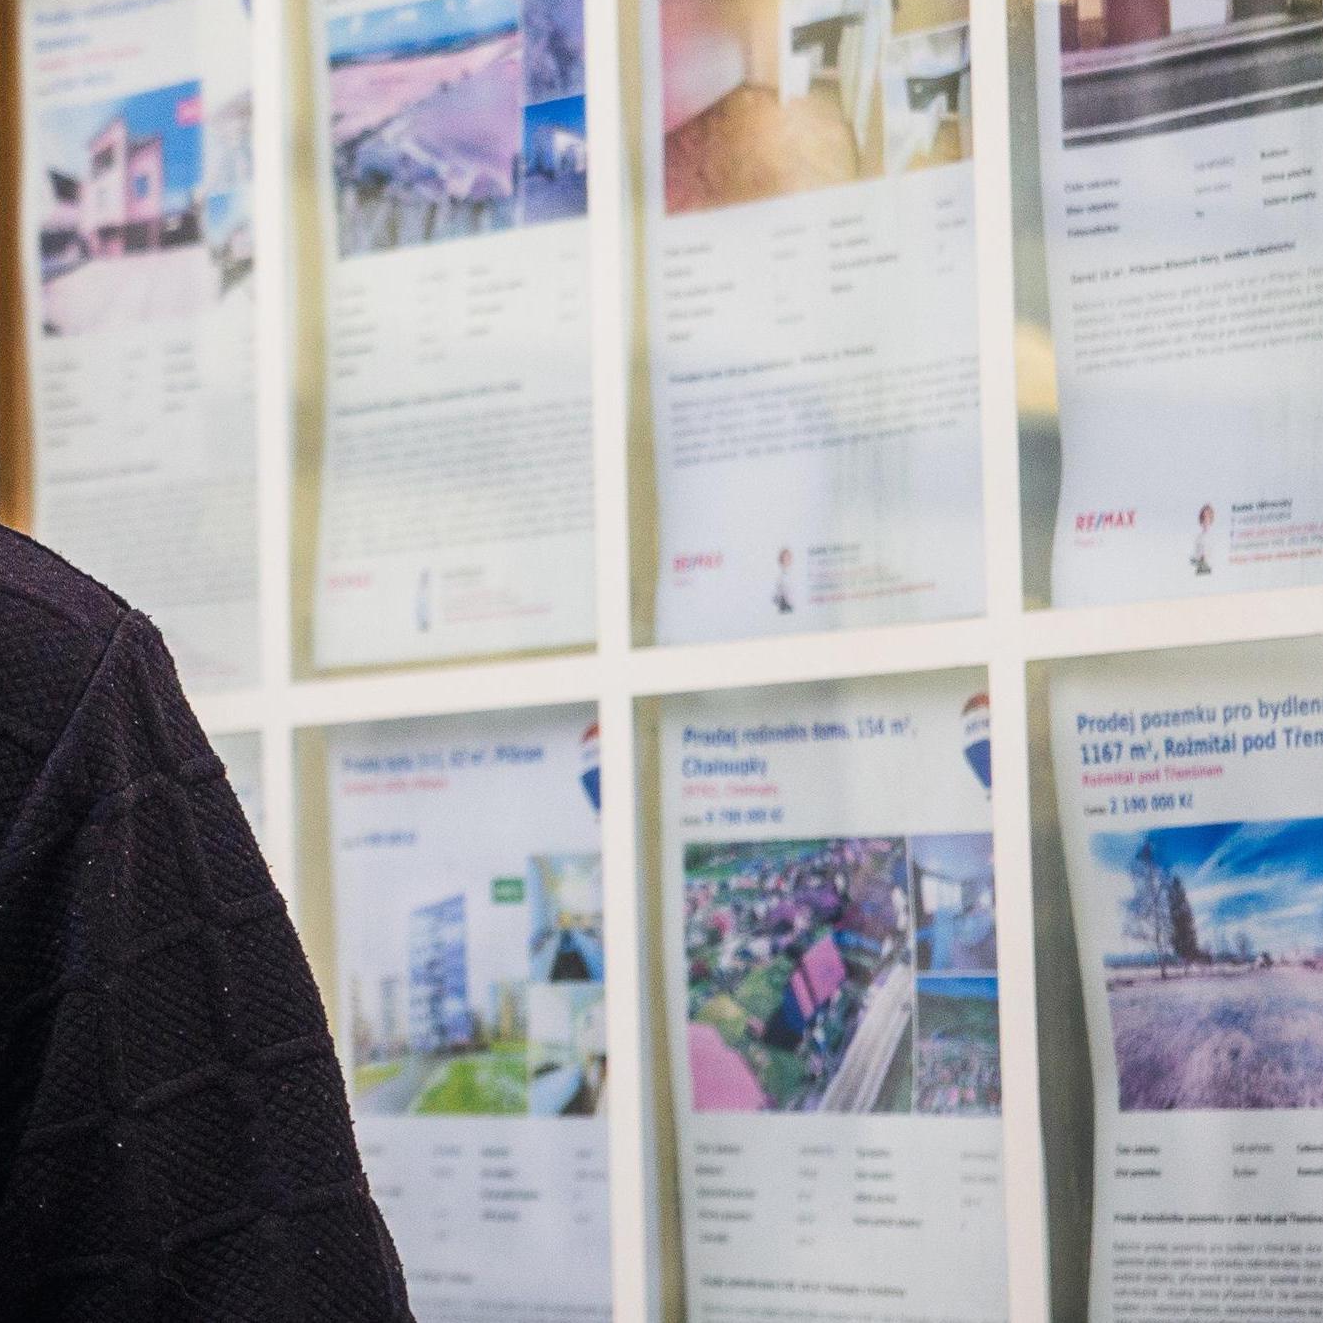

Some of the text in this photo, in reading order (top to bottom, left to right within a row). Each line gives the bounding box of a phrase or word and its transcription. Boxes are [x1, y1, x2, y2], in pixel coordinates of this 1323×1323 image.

[1076, 711, 1135, 735] Prodej
[1140, 706, 1217, 731] pozemku
[1222, 703, 1252, 725] pro
[1081, 741, 1123, 765] 1167
[1163, 733, 1236, 758] Rožmitál
[1241, 730, 1277, 755] pod
